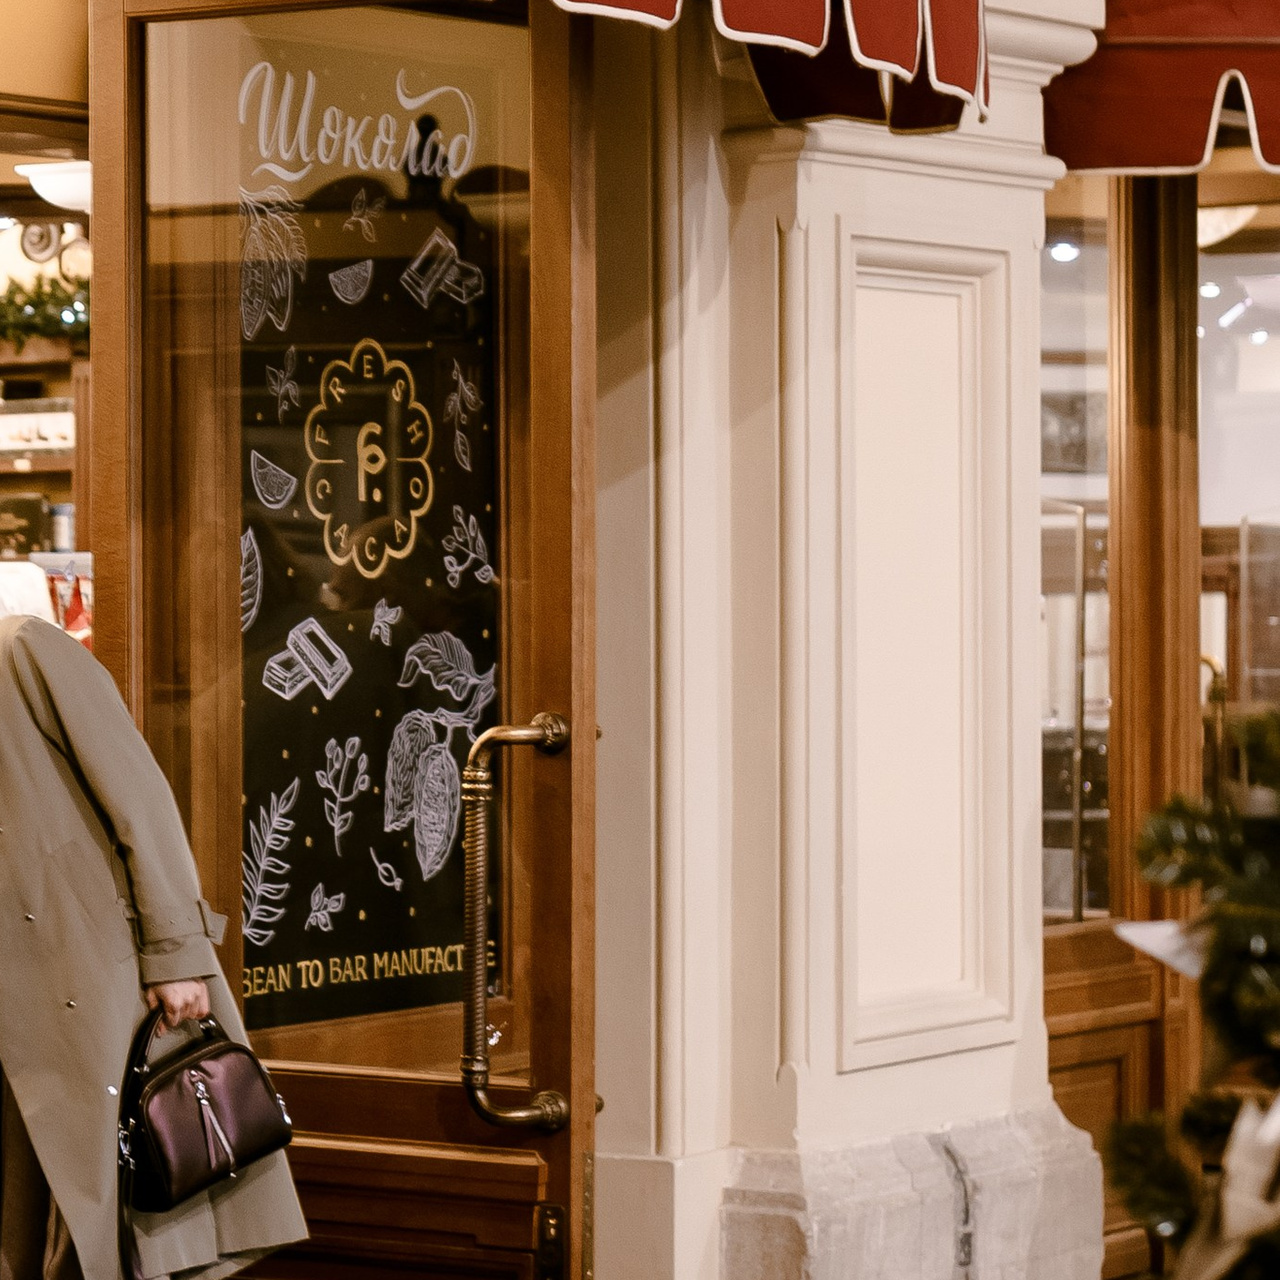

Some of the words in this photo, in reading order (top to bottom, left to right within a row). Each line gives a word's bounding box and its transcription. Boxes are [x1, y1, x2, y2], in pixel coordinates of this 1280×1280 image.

[238, 61, 477, 179] Шоколад
[243, 963, 291, 997] BEAN
[297, 959, 324, 990] TO
[329, 954, 368, 984] BAR
